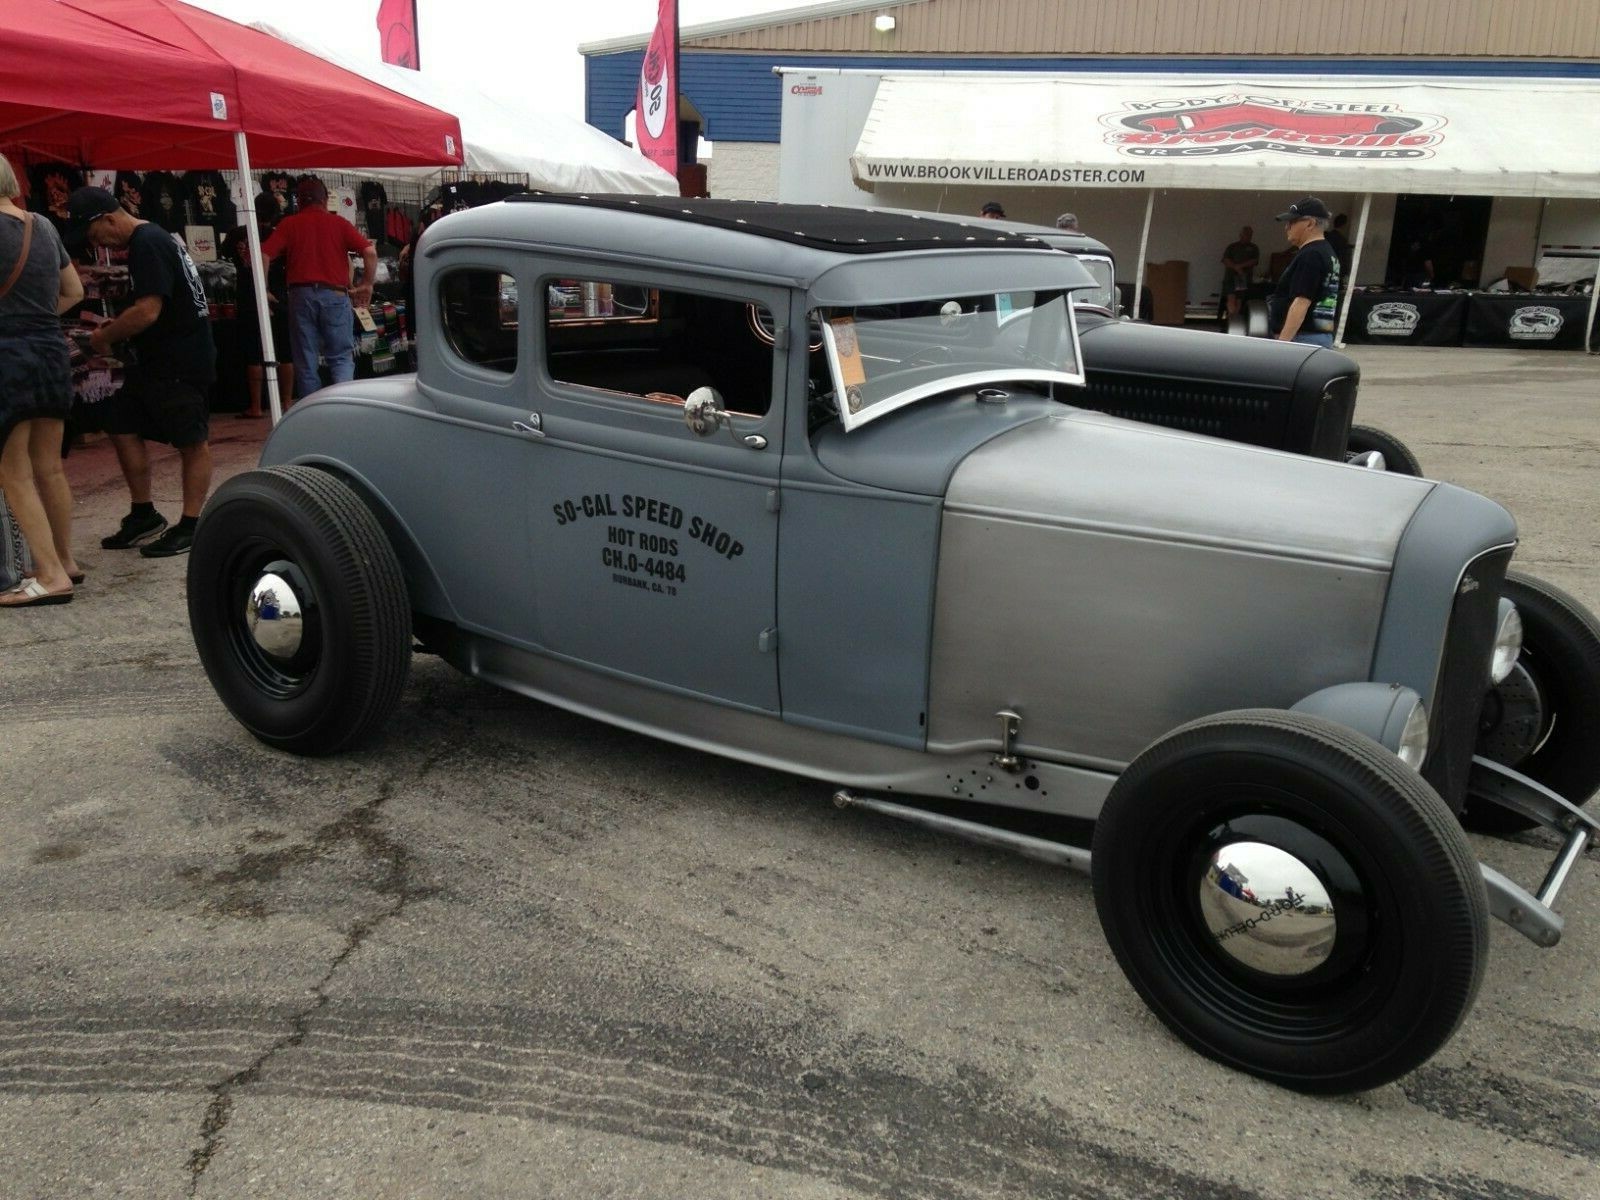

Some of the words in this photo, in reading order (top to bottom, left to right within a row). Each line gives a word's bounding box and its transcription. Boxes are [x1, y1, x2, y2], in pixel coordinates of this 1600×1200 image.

[1131, 96, 1226, 111] BODY
[1246, 95, 1295, 107] OF
[1312, 102, 1394, 113] STEEL
[1116, 127, 1431, 146] Brookville
[1148, 142, 1405, 158] ROADSTER
[867, 164, 1146, 183] WWW.BROOKVILLEROADSTER.COM
[553, 494, 617, 525] SO-CAL
[622, 494, 684, 529] SPEED
[688, 516, 744, 560] SHOP
[608, 526, 635, 547] HOT
[639, 533, 678, 557] RODS
